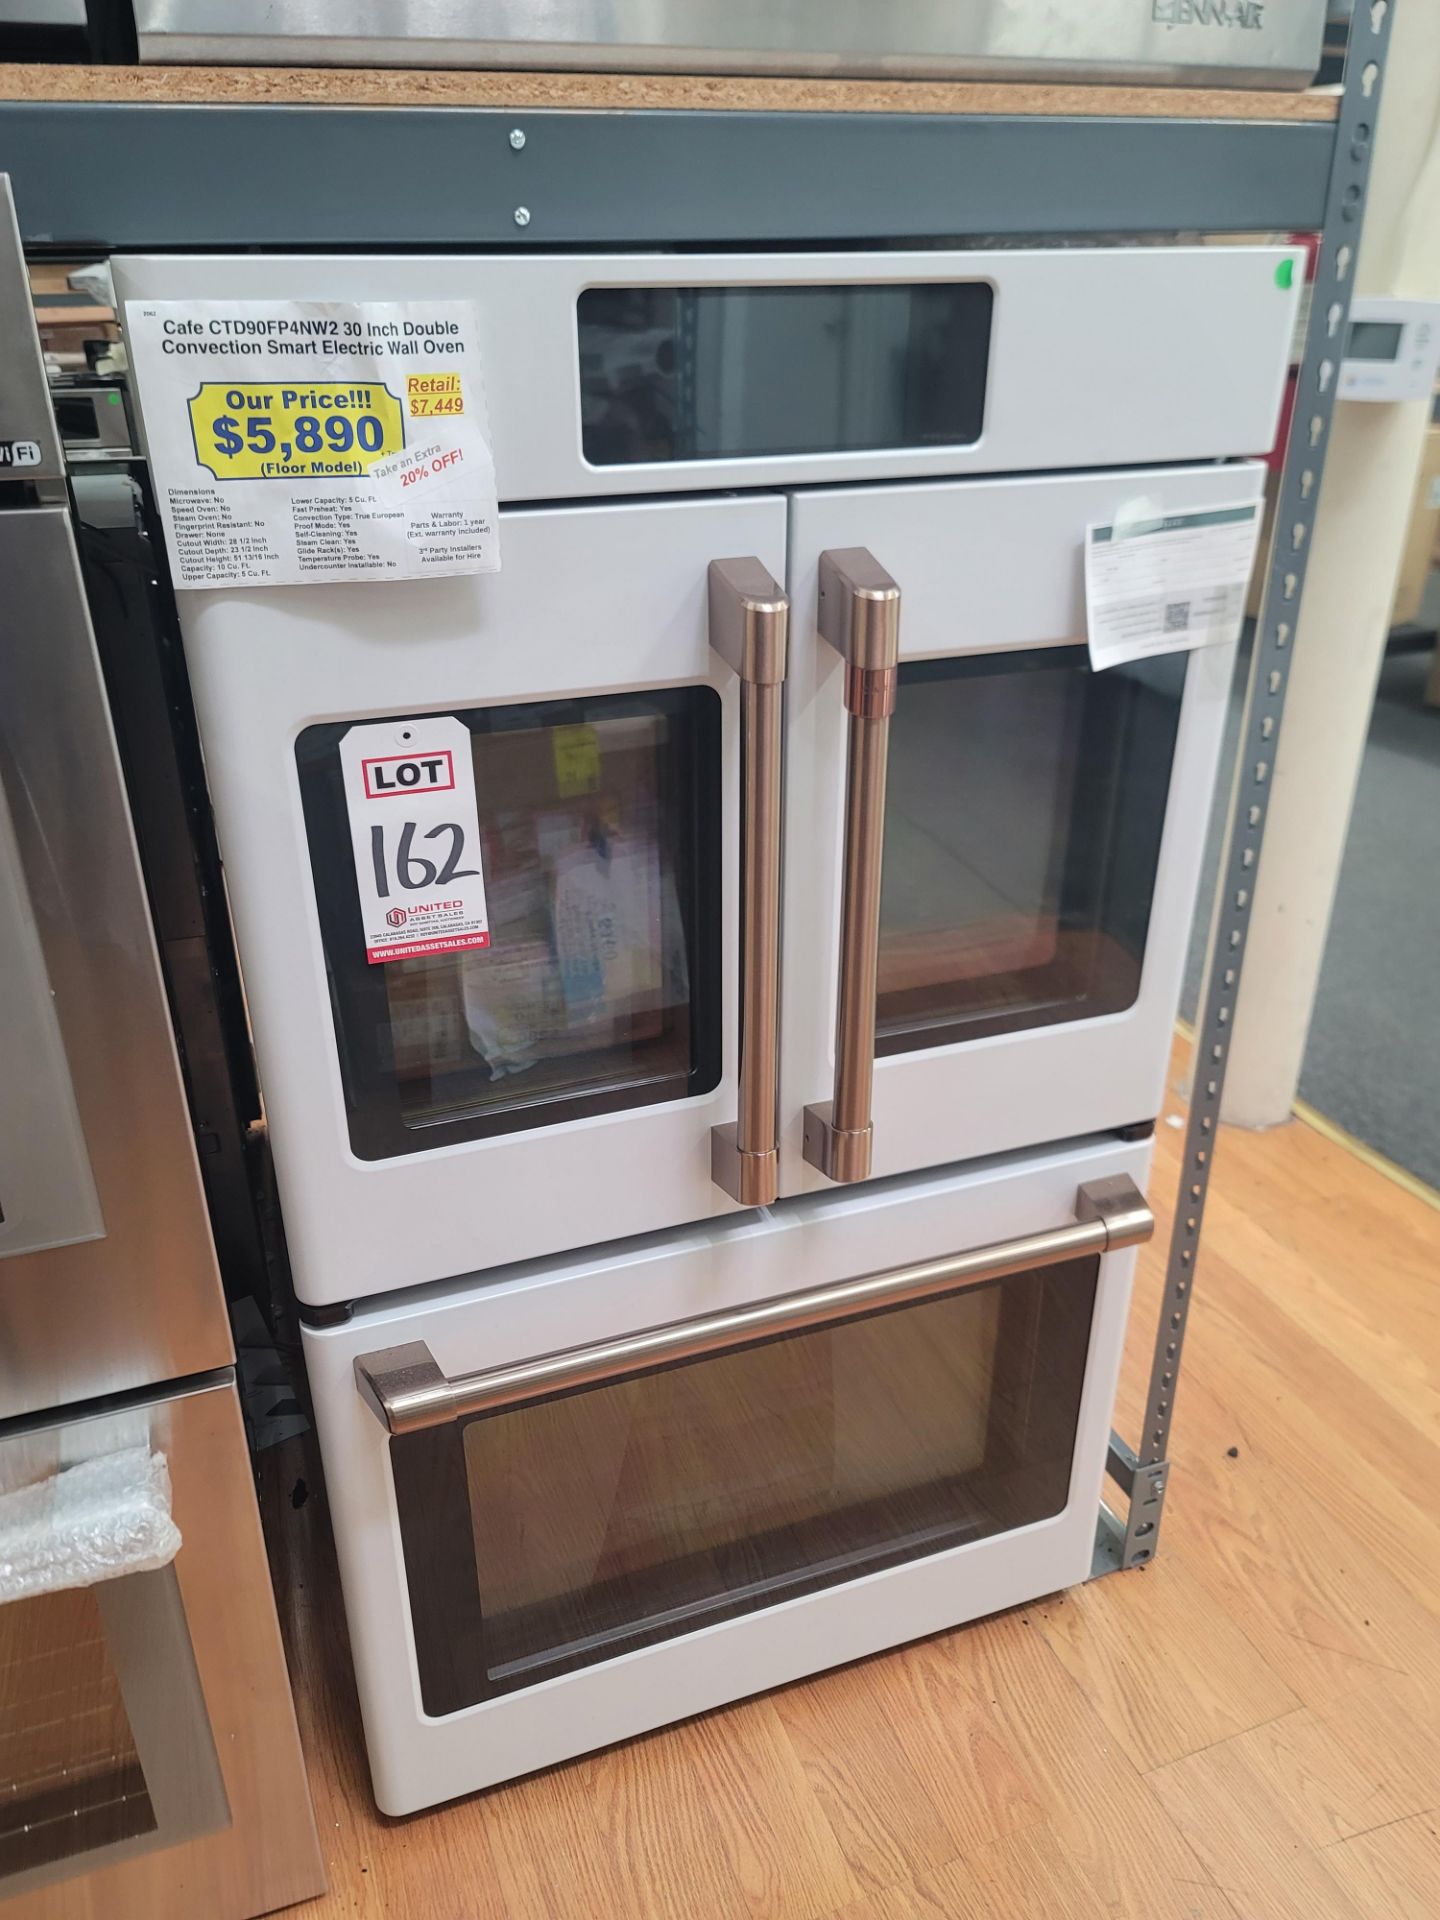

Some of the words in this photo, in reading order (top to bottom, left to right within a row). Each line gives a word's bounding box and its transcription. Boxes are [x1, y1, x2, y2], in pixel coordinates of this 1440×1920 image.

[163, 319, 204, 335] Cafe
[209, 320, 339, 336] CTD90FP4NW2
[343, 321, 362, 336] 30
[368, 322, 398, 337] Inch
[403, 321, 459, 336] Double
[162, 339, 262, 355] Convection
[267, 339, 317, 355] Smart
[322, 340, 384, 355] Electric
[387, 340, 418, 355] Wall
[423, 340, 465, 354] Oven
[408, 376, 461, 392] Retail:
[226, 390, 273, 410] Our
[282, 390, 371, 409] Price!!!
[410, 397, 463, 416] $7,449
[212, 415, 384, 462] $5,890
[373, 464, 398, 480] Take
[400, 458, 413, 469] an
[414, 444, 442, 462] Extra
[261, 462, 307, 479] (Floor
[311, 461, 363, 477] Model)
[400, 469, 429, 488] 20%
[431, 448, 464, 474] OFF!
[168, 488, 216, 496] Dimensions
[314, 497, 347, 505] Capacity:
[171, 506, 194, 514] Speed
[431, 511, 463, 519] Warranty
[173, 514, 196, 522] Steam
[334, 513, 353, 521] Type:
[372, 512, 405, 520] European
[174, 523, 215, 531] Fingerprint
[216, 521, 253, 529] Resistant:
[470, 519, 485, 527] year
[175, 531, 204, 539] Drawer:
[295, 531, 344, 539] Self-Cleaning:
[407, 531, 423, 539] (Ext.
[425, 529, 456, 537] warranty
[458, 526, 491, 535] included)
[178, 548, 203, 556] Cutout
[205, 547, 229, 555] Depth:
[317, 547, 346, 555] Rack(s):
[429, 546, 448, 554] Party
[450, 544, 482, 552] Installers
[179, 556, 204, 564] Cutout
[206, 555, 231, 564] Height:
[298, 555, 341, 563] Temperature
[421, 554, 454, 563] Available
[181, 564, 215, 573] Capacity:
[299, 563, 346, 571] Undercounter
[348, 561, 385, 569] Installable:
[182, 573, 204, 581] Upper
[206, 571, 239, 579] Capacity:
[374, 759, 443, 790] LOT
[370, 822, 480, 898] 162
[408, 900, 463, 914] UNITED
[410, 914, 436, 922] ASSET
[438, 910, 464, 918] SALES
[372, 936, 484, 959] WWW.UNITEDASSETSALES.COM
